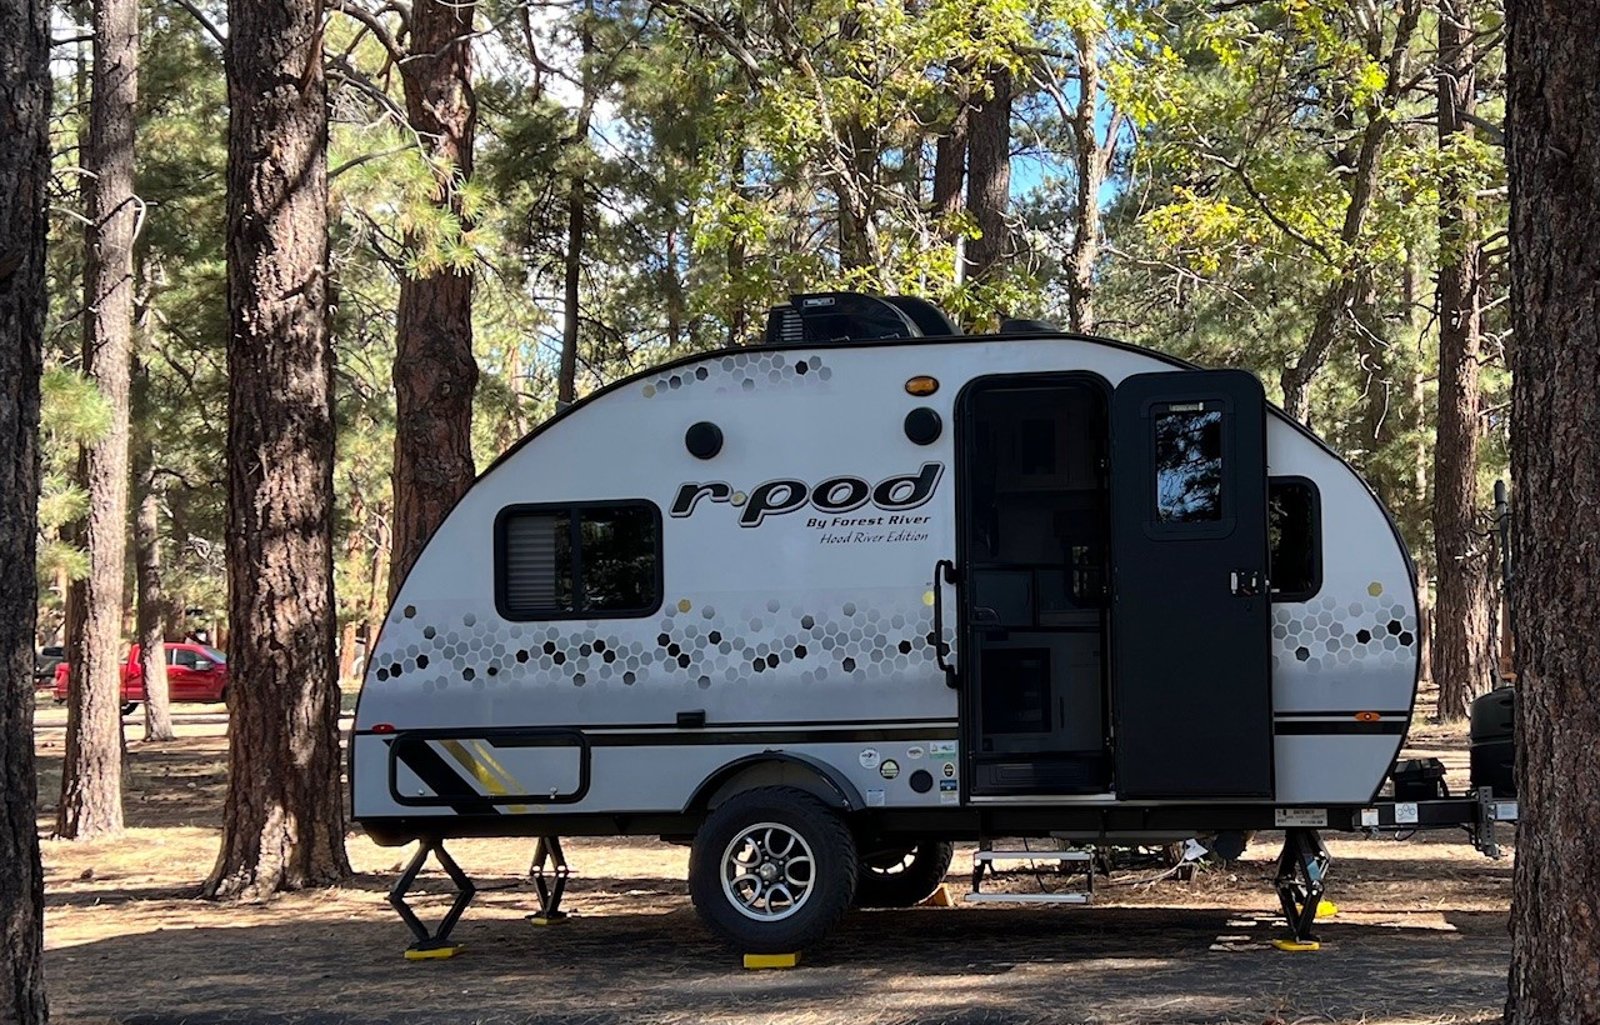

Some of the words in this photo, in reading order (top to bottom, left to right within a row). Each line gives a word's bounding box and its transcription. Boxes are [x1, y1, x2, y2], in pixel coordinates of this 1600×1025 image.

[807, 518, 827, 530] By
[831, 517, 884, 527] Forest
[888, 515, 931, 525] River
[820, 530, 853, 544] Hood
[854, 531, 884, 543] River
[886, 529, 929, 543] Edition
